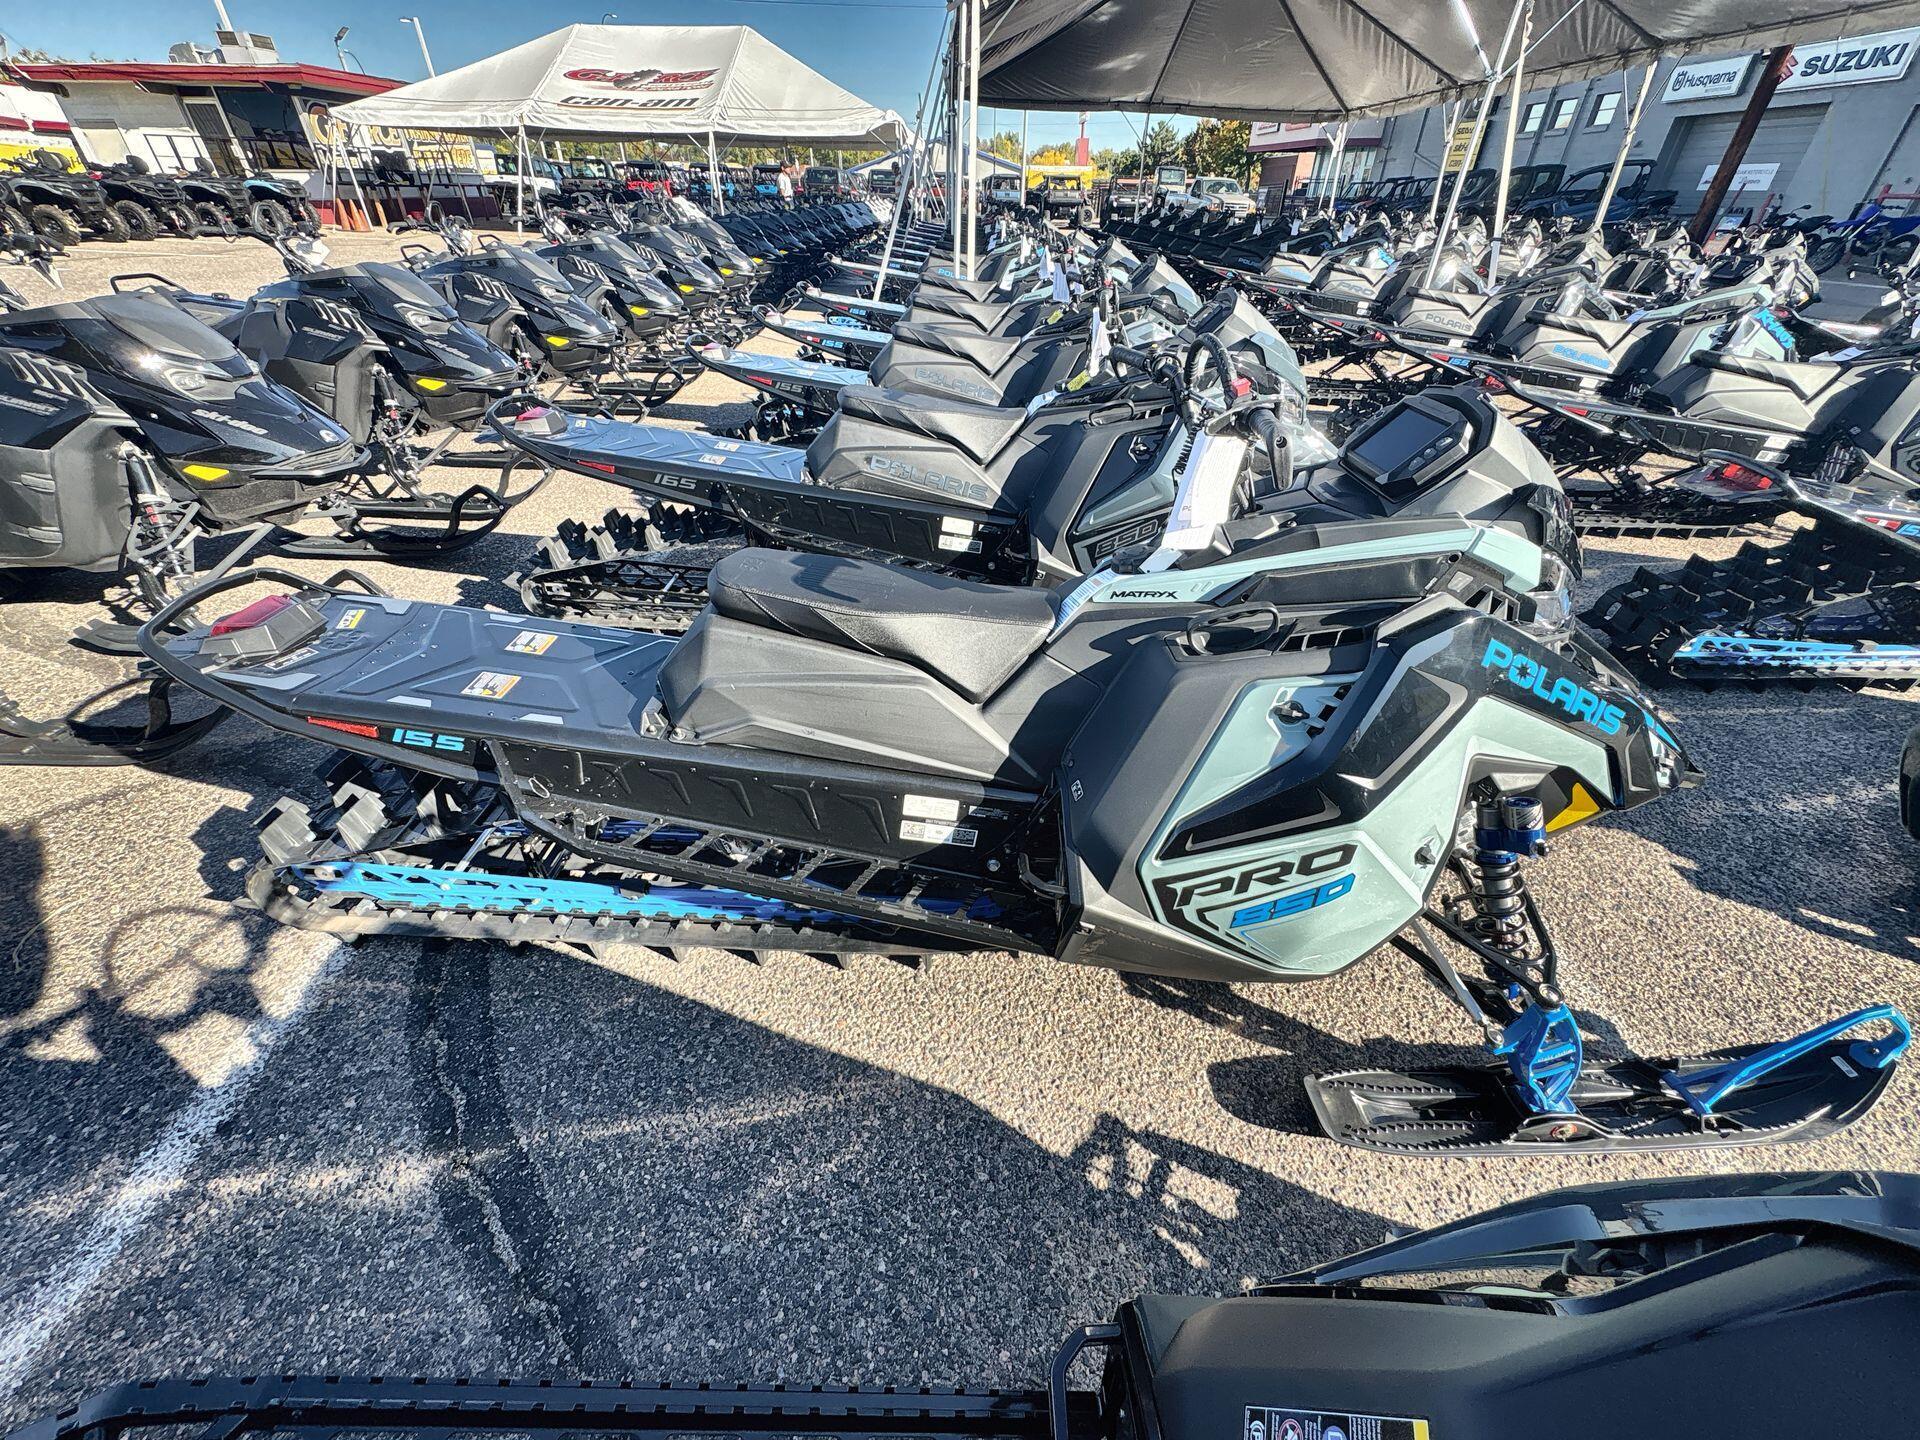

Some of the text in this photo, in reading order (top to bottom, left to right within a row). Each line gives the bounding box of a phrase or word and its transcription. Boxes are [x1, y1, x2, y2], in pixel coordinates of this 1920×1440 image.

[1801, 43, 1910, 77] SUZUKI
[1684, 71, 1738, 88] Husqvarna
[560, 96, 700, 107] can-am
[1337, 281, 1375, 296] PRO
[1425, 313, 1473, 332] POLARIS
[822, 338, 844, 349] 155
[1448, 357, 1471, 367] 155
[1553, 344, 1611, 370] POLARIS
[775, 381, 804, 393] 155
[915, 367, 996, 401] POLARIS
[192, 408, 269, 435] ski-doo
[1587, 411, 1617, 423] 155
[653, 473, 698, 491] 165
[870, 454, 989, 502] POLARIS
[1094, 519, 1159, 558] 850
[1896, 523, 1920, 539] 15
[1110, 590, 1179, 599] MATRYX
[1481, 637, 1627, 736] POLARIS
[392, 728, 466, 752] 155
[1175, 843, 1359, 908] PRO
[1229, 872, 1357, 929] 850
